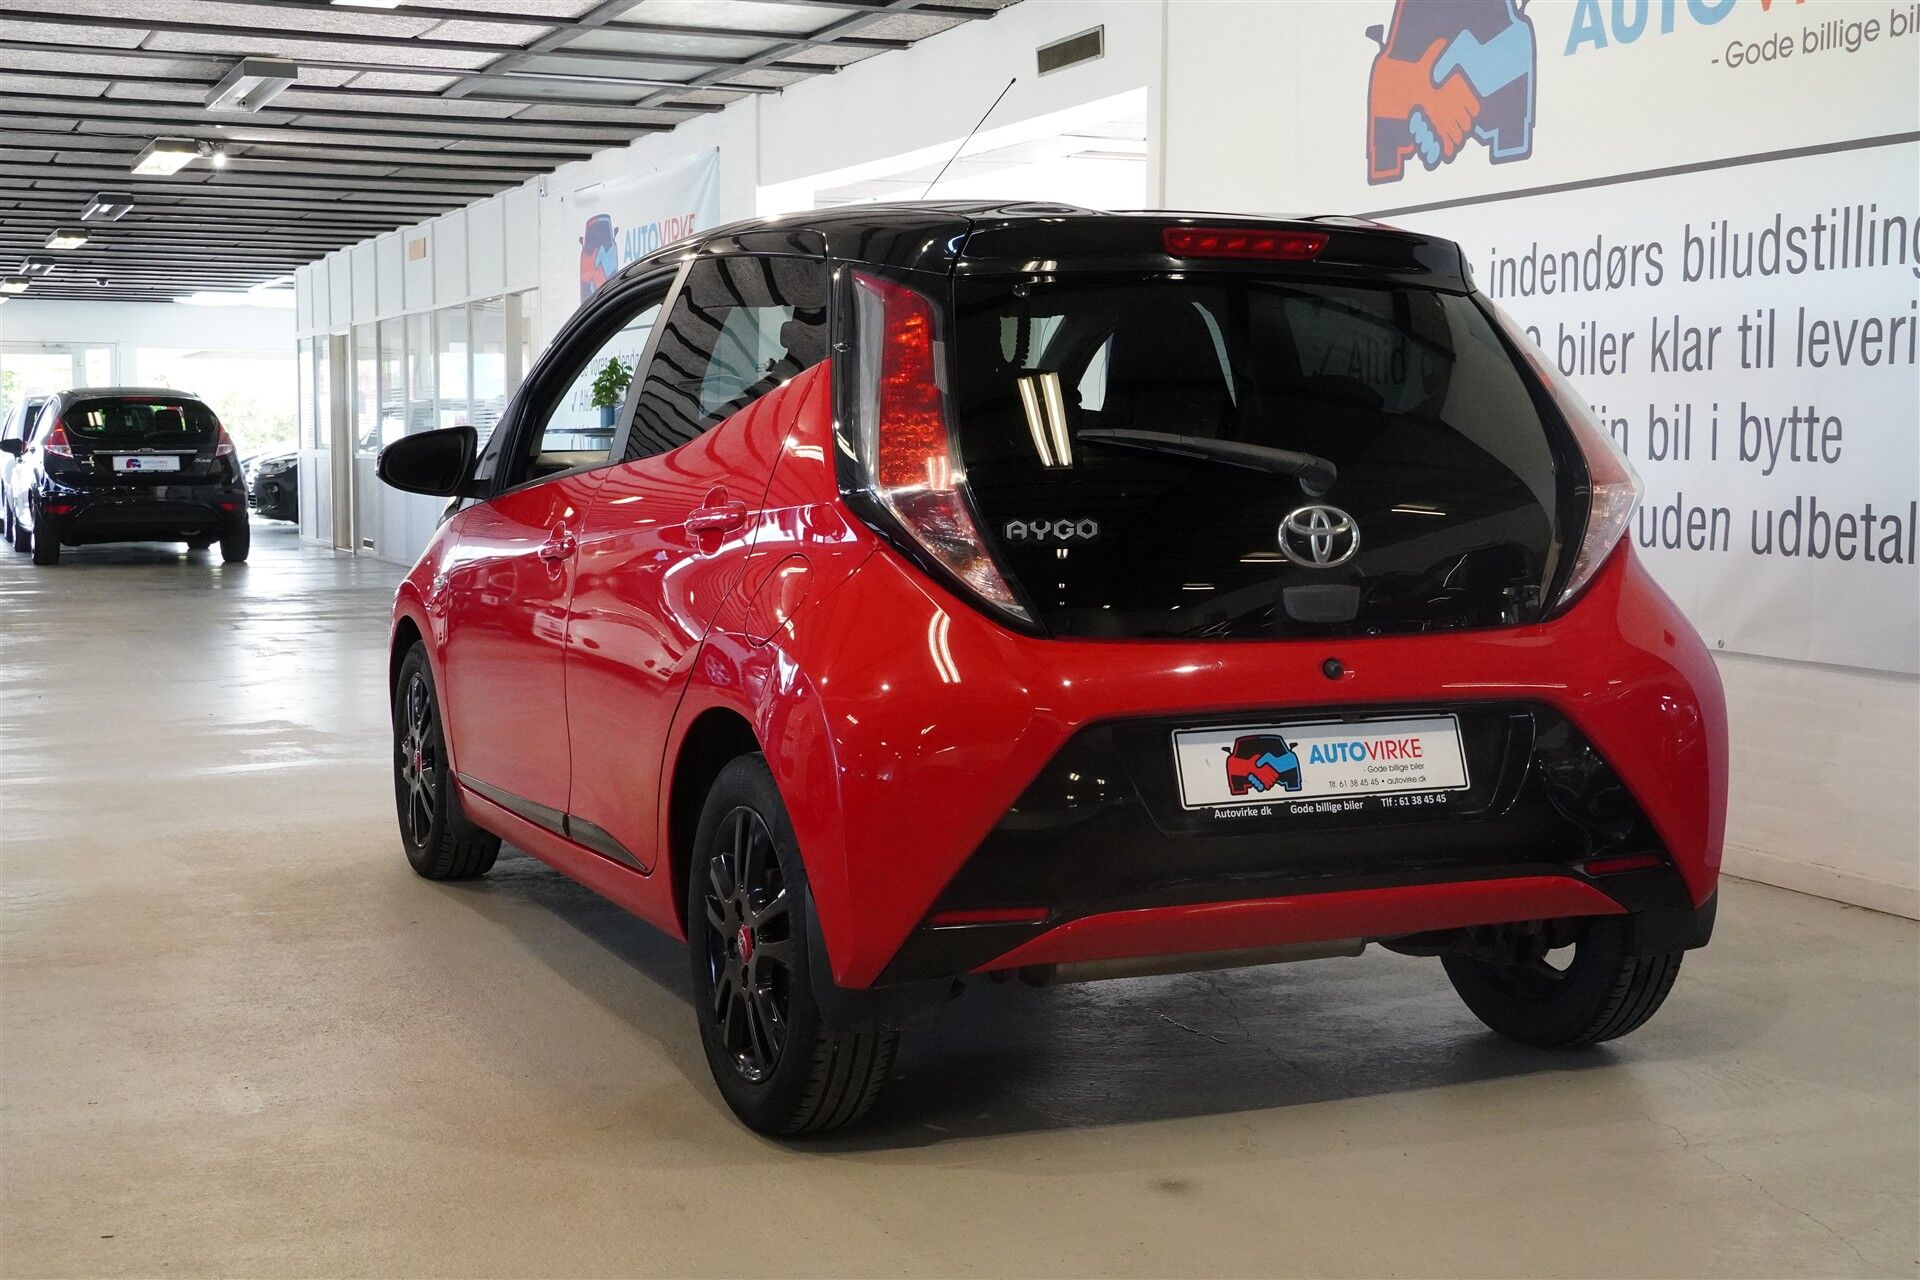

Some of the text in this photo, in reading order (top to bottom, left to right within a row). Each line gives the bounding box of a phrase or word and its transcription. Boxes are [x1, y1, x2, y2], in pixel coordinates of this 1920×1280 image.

[1725, 33, 1793, 68] Gode
[1803, 20, 1880, 54] billige
[1890, 4, 1920, 37] bil
[1489, 235, 1664, 298] indendørs
[1558, 300, 1918, 377] biler klar til leveri
[1648, 403, 1691, 462] bil
[1711, 403, 1719, 462] i
[1739, 402, 1843, 477] bytte
[1006, 519, 1098, 540] AYGO
[1638, 492, 1917, 565] uden udbetal
[1309, 738, 1423, 764] AUTOVIRKE
[1367, 765, 1387, 773] Gode
[1339, 780, 1347, 788] 61
[1350, 779, 1359, 788] 38
[1360, 778, 1369, 787] 45
[1370, 778, 1380, 786] 45
[1386, 775, 1427, 785] autovirke.dk
[1214, 806, 1272, 819] Autovirke dk
[1290, 800, 1364, 814] Gode billige biler
[1380, 797, 1393, 808] Tlf
[1399, 796, 1410, 806] 61
[1412, 795, 1423, 805] 38
[1424, 795, 1435, 805] 45
[1436, 794, 1447, 804] 45
